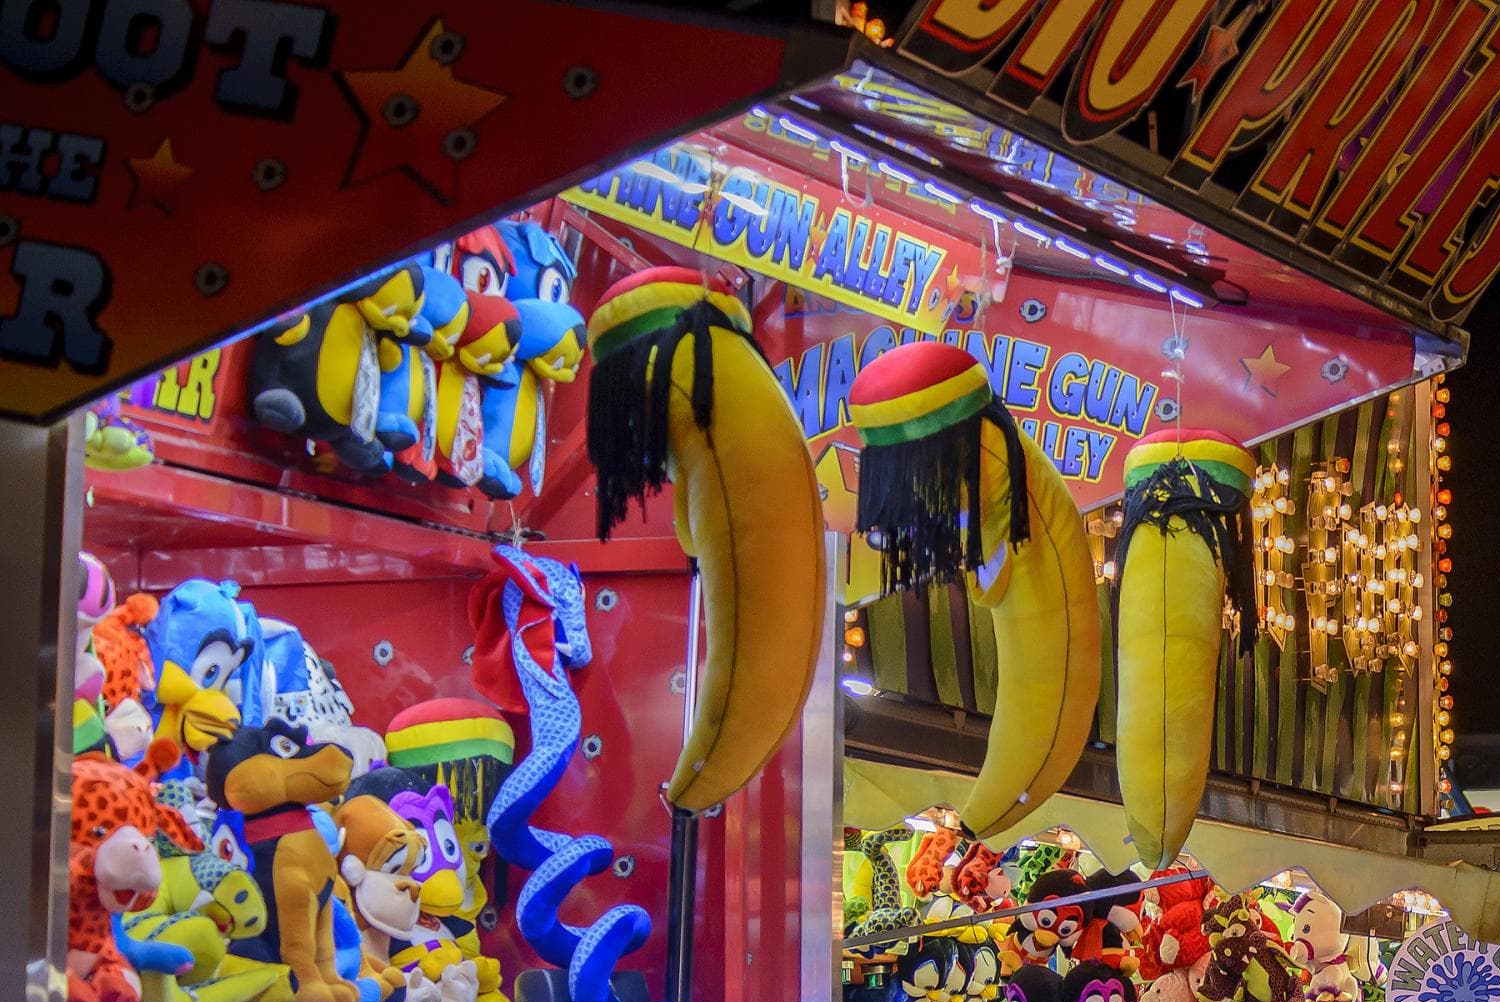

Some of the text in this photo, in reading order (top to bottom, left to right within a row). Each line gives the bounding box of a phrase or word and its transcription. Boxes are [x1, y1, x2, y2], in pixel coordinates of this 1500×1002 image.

[713, 173, 816, 271] GUN
[814, 211, 943, 313] ALLEY
[773, 325, 1156, 440] MANE GUN
